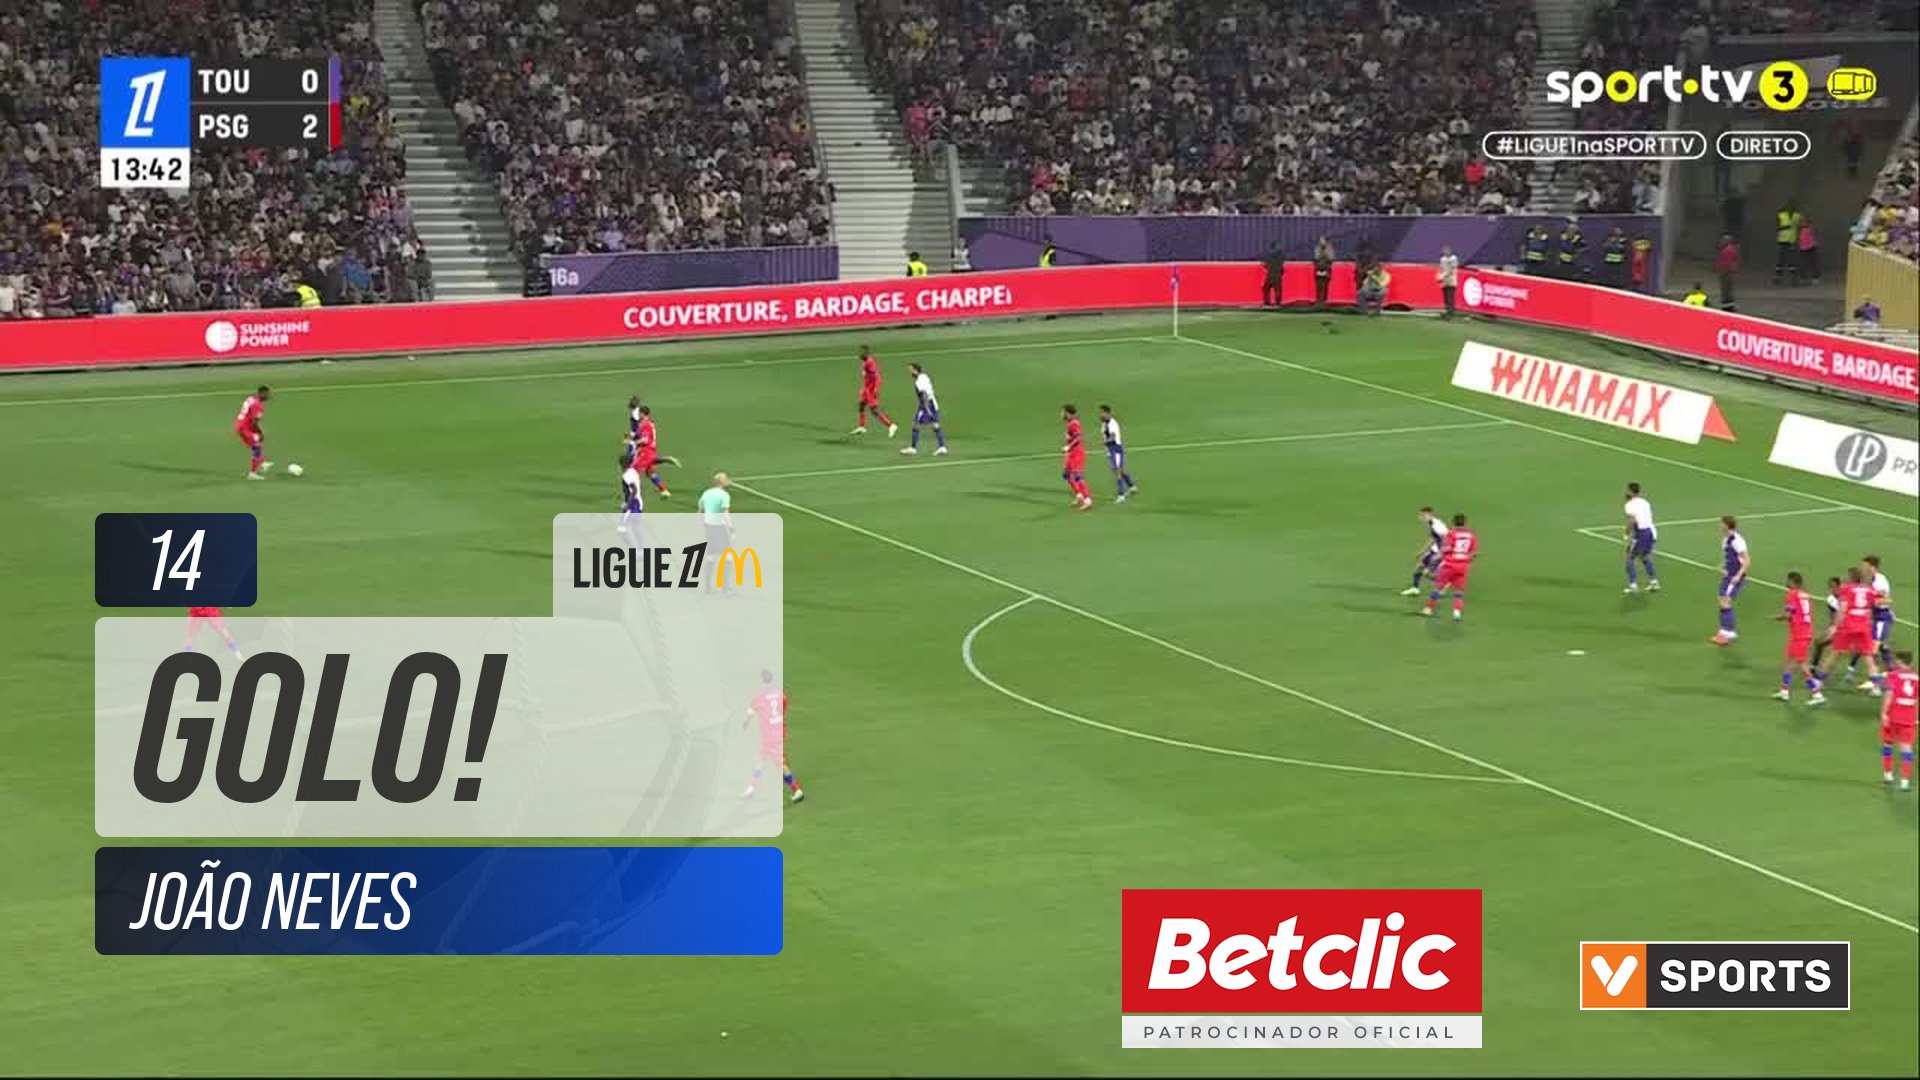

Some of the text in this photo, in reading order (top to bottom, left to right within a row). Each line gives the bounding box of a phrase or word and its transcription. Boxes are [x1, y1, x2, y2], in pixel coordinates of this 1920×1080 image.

[240, 321, 311, 335] SUNSHINE
[623, 299, 788, 329] COUVERTURE,
[795, 292, 910, 319] BARDAGE,
[240, 334, 289, 348] POWER
[1717, 329, 1829, 375] COUVERTURE,
[1491, 352, 1671, 433] WINAMAX
[1844, 435, 1881, 478] LP
